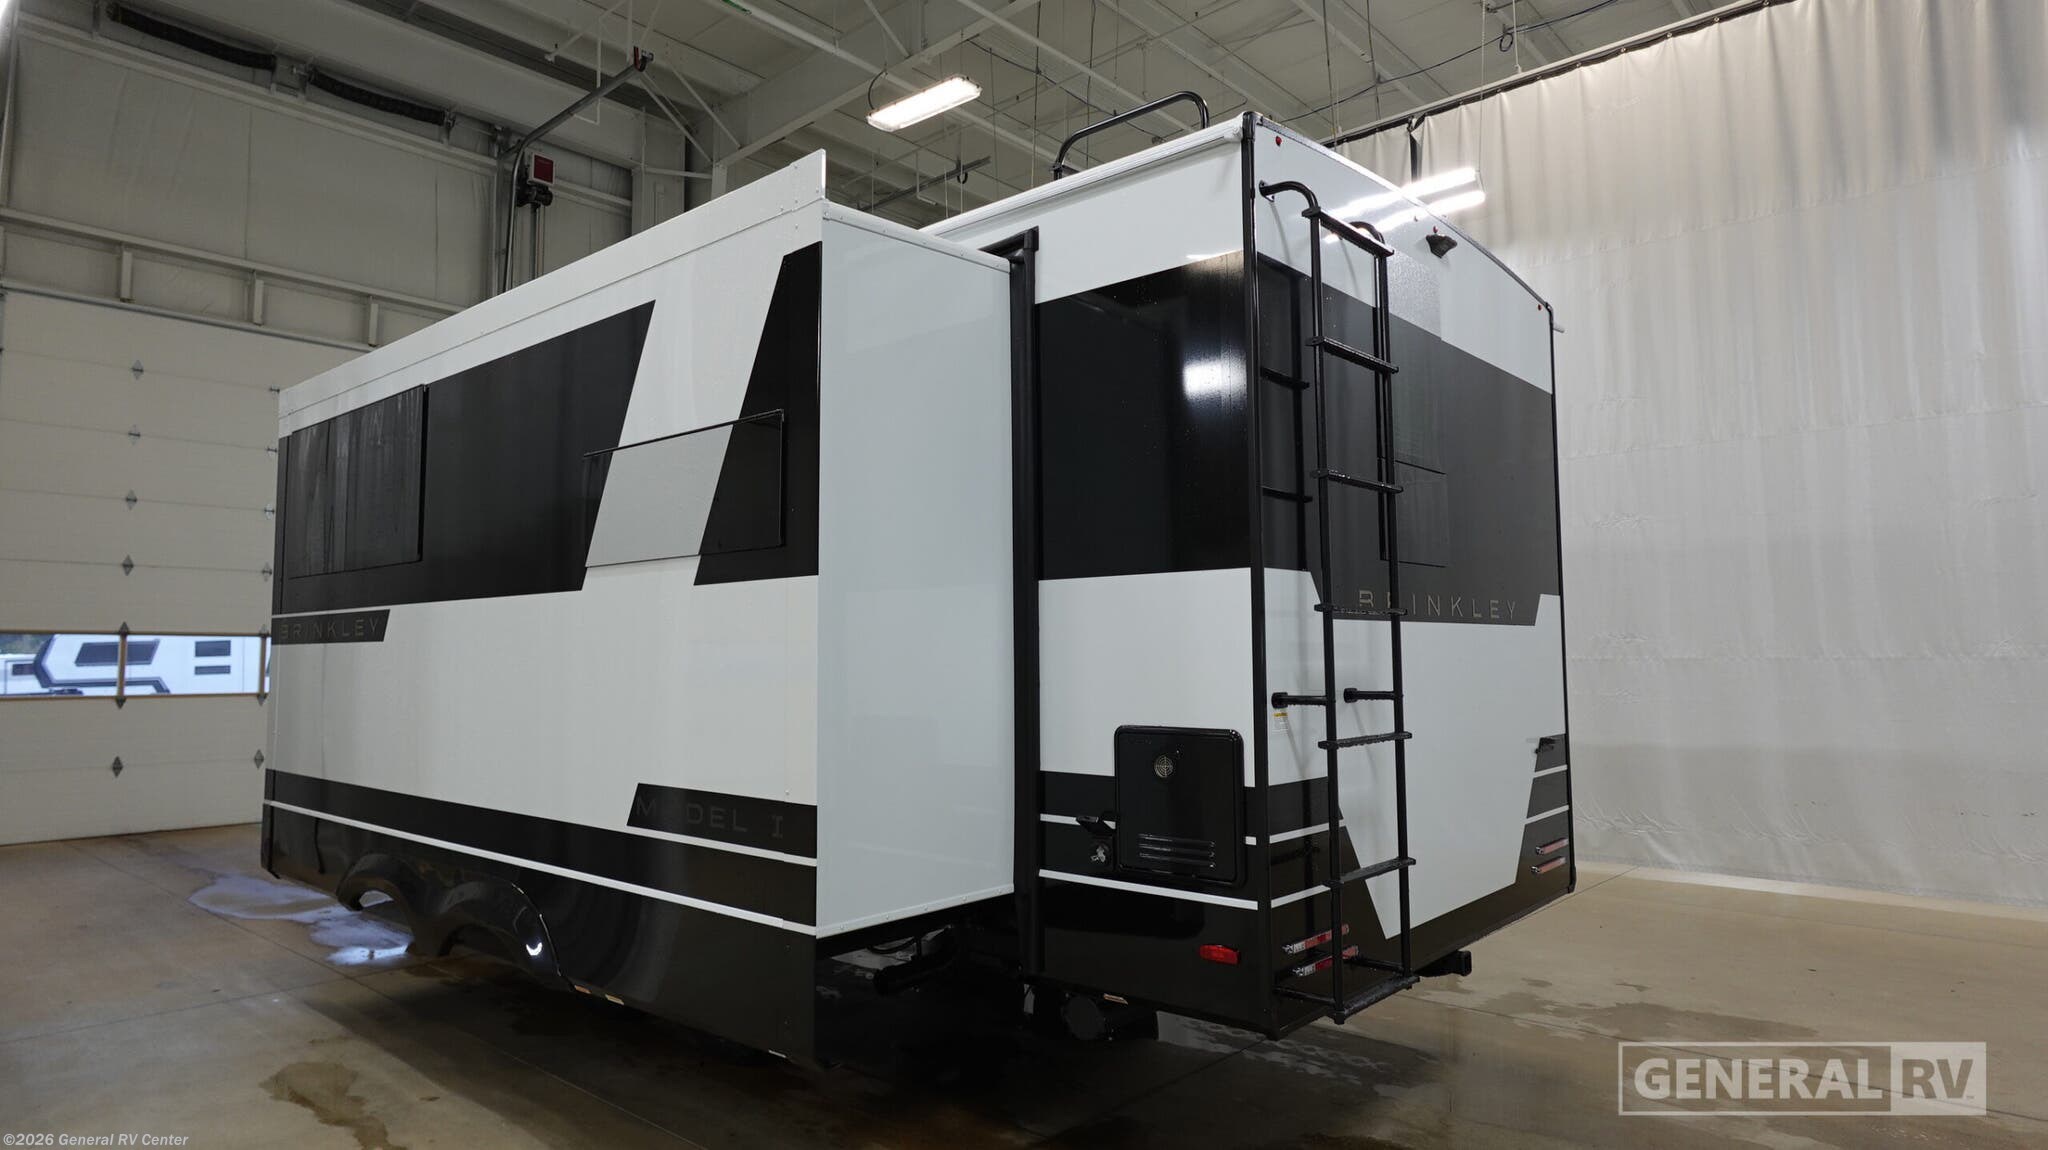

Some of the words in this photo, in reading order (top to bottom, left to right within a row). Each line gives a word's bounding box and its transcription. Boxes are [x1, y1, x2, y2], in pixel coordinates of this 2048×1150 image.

[1358, 589, 1517, 620] BINKLEY
[279, 616, 380, 640] BRINKLEY
[635, 794, 748, 833] MDEL
